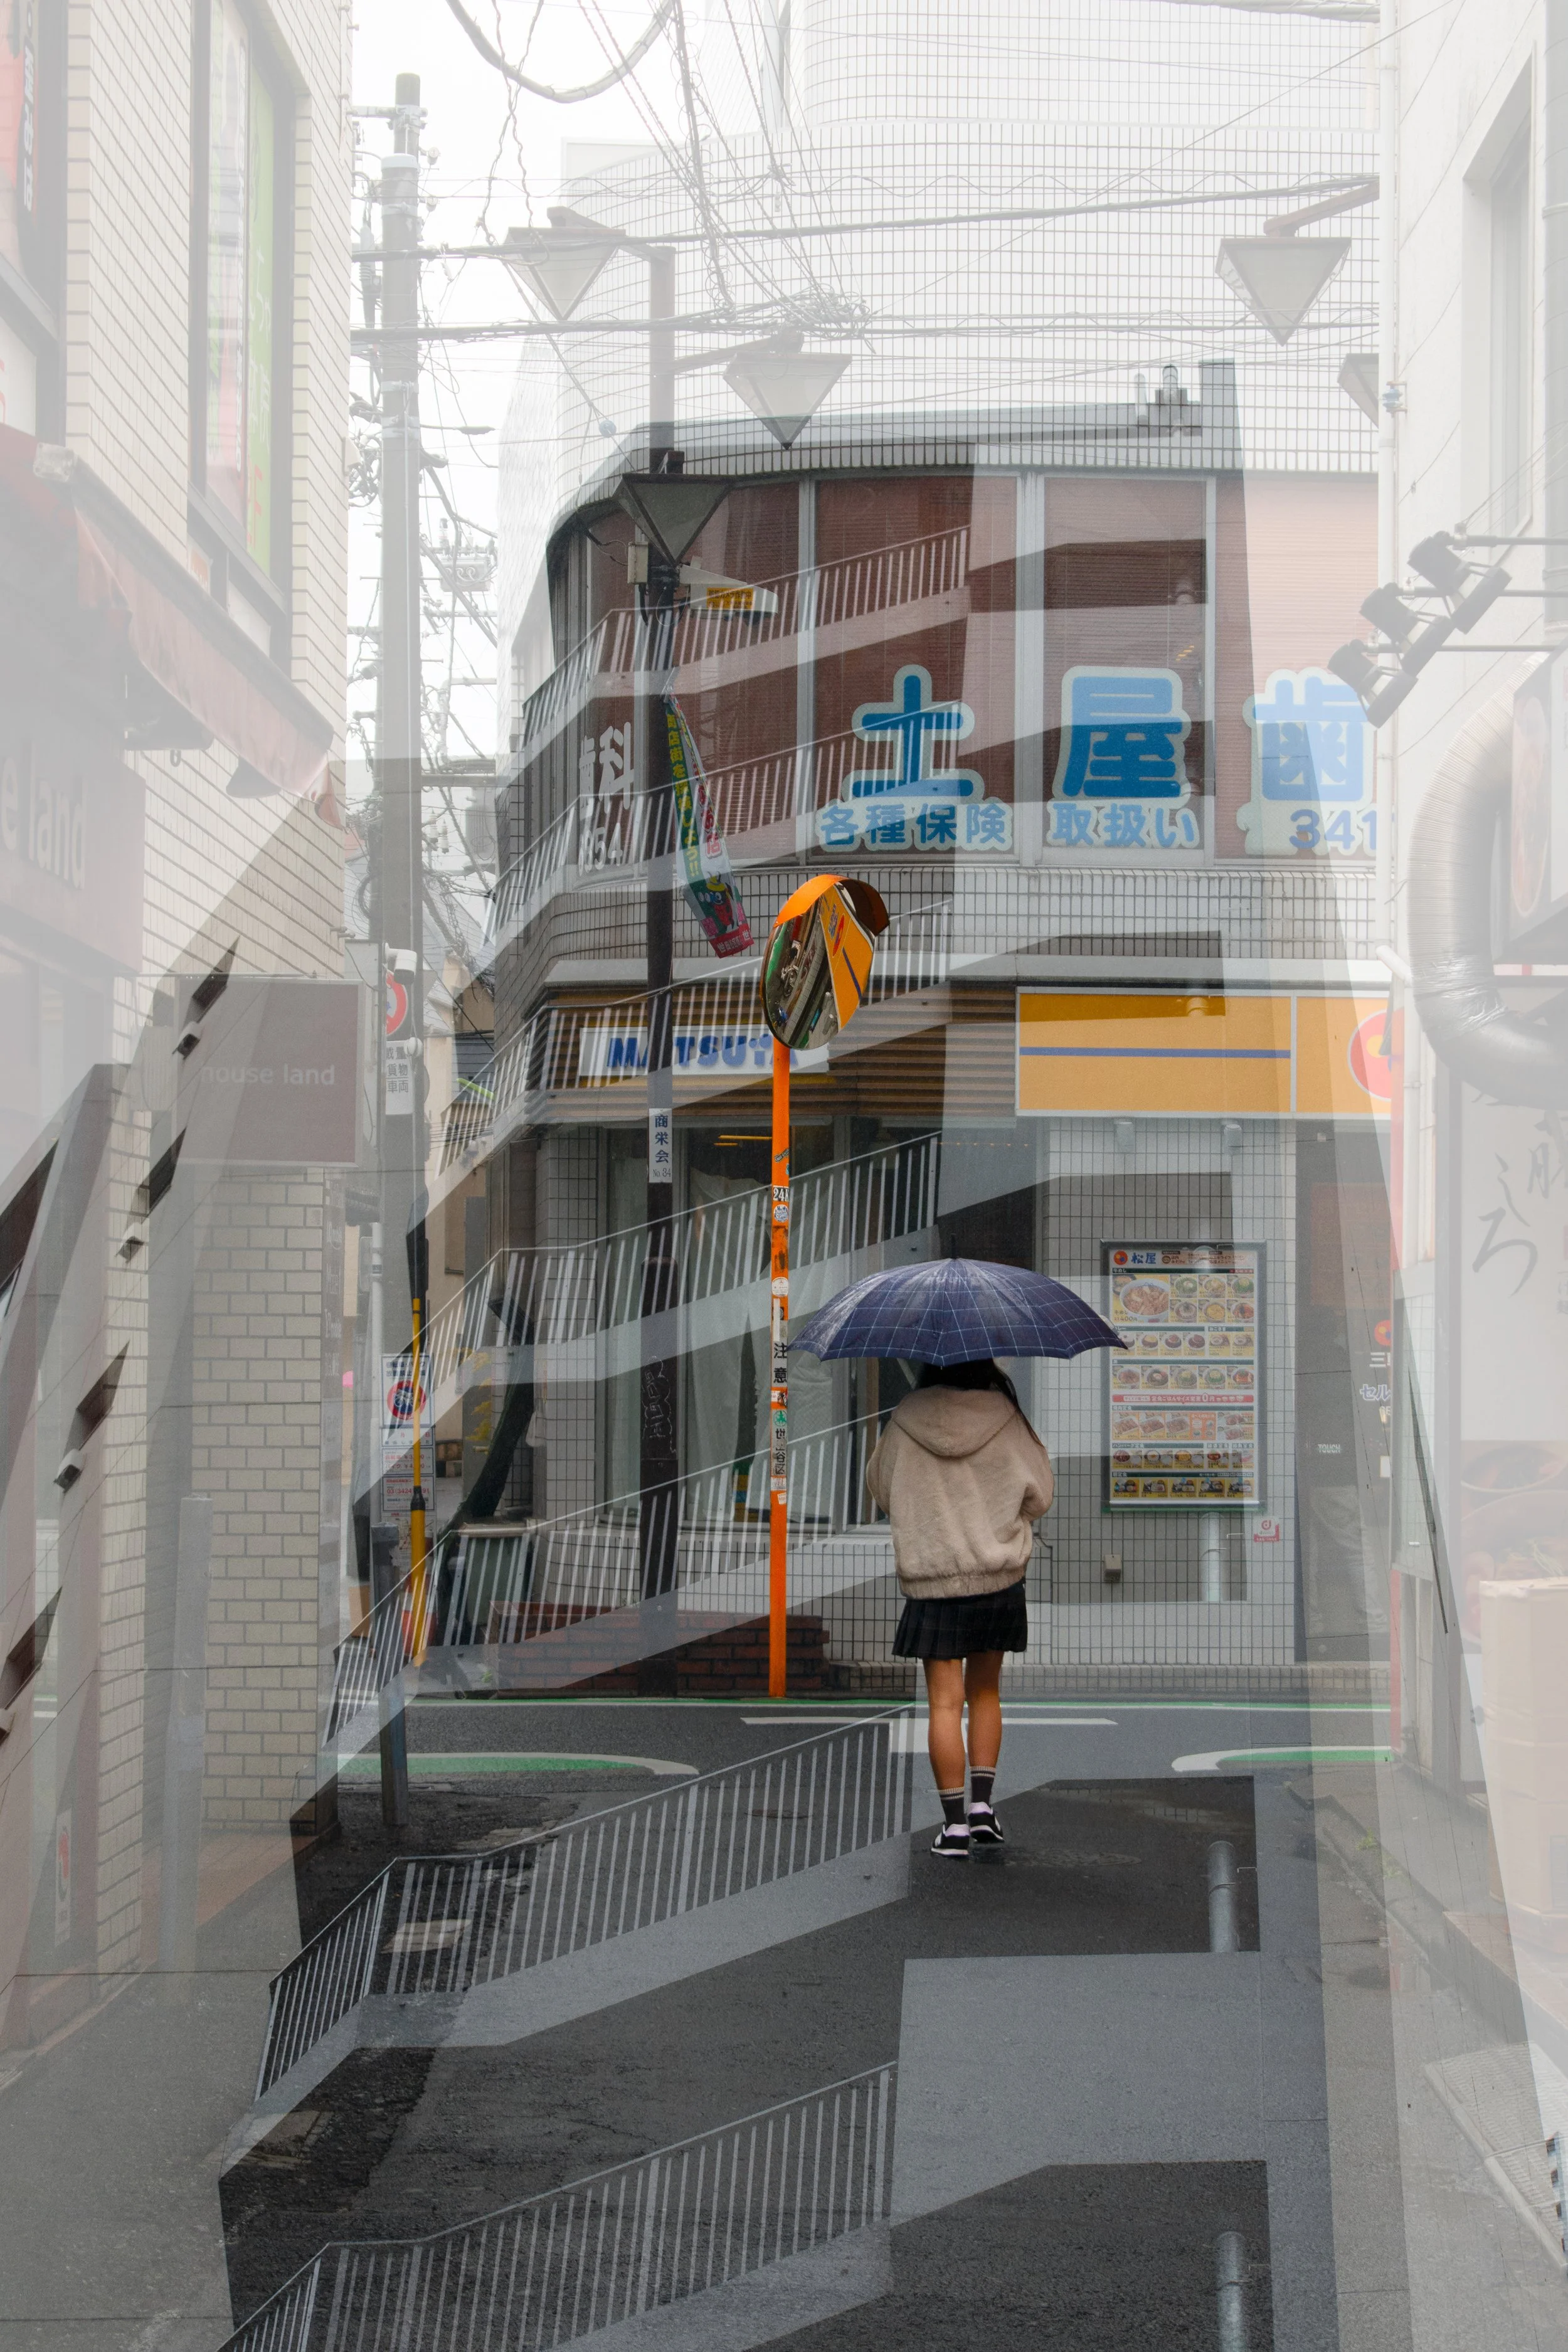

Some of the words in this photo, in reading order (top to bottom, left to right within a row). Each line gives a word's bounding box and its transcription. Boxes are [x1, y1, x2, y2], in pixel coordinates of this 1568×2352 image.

[579, 721, 634, 820] 歯科
[28, 742, 87, 890] land
[820, 803, 1007, 847] 各種保険
[1052, 803, 1197, 848] 取扱い
[283, 1062, 335, 1086] land
[386, 1063, 408, 1077] 貨物
[387, 1079, 409, 1094] 車両
[654, 1114, 669, 1164] 商栄会
[662, 1168, 671, 1178] 34
[1131, 1252, 1157, 1264] 松屋
[773, 1341, 788, 1384] 注意
[775, 1428, 786, 1475] 世谷区
[1317, 1443, 1341, 1454] TOUCH
